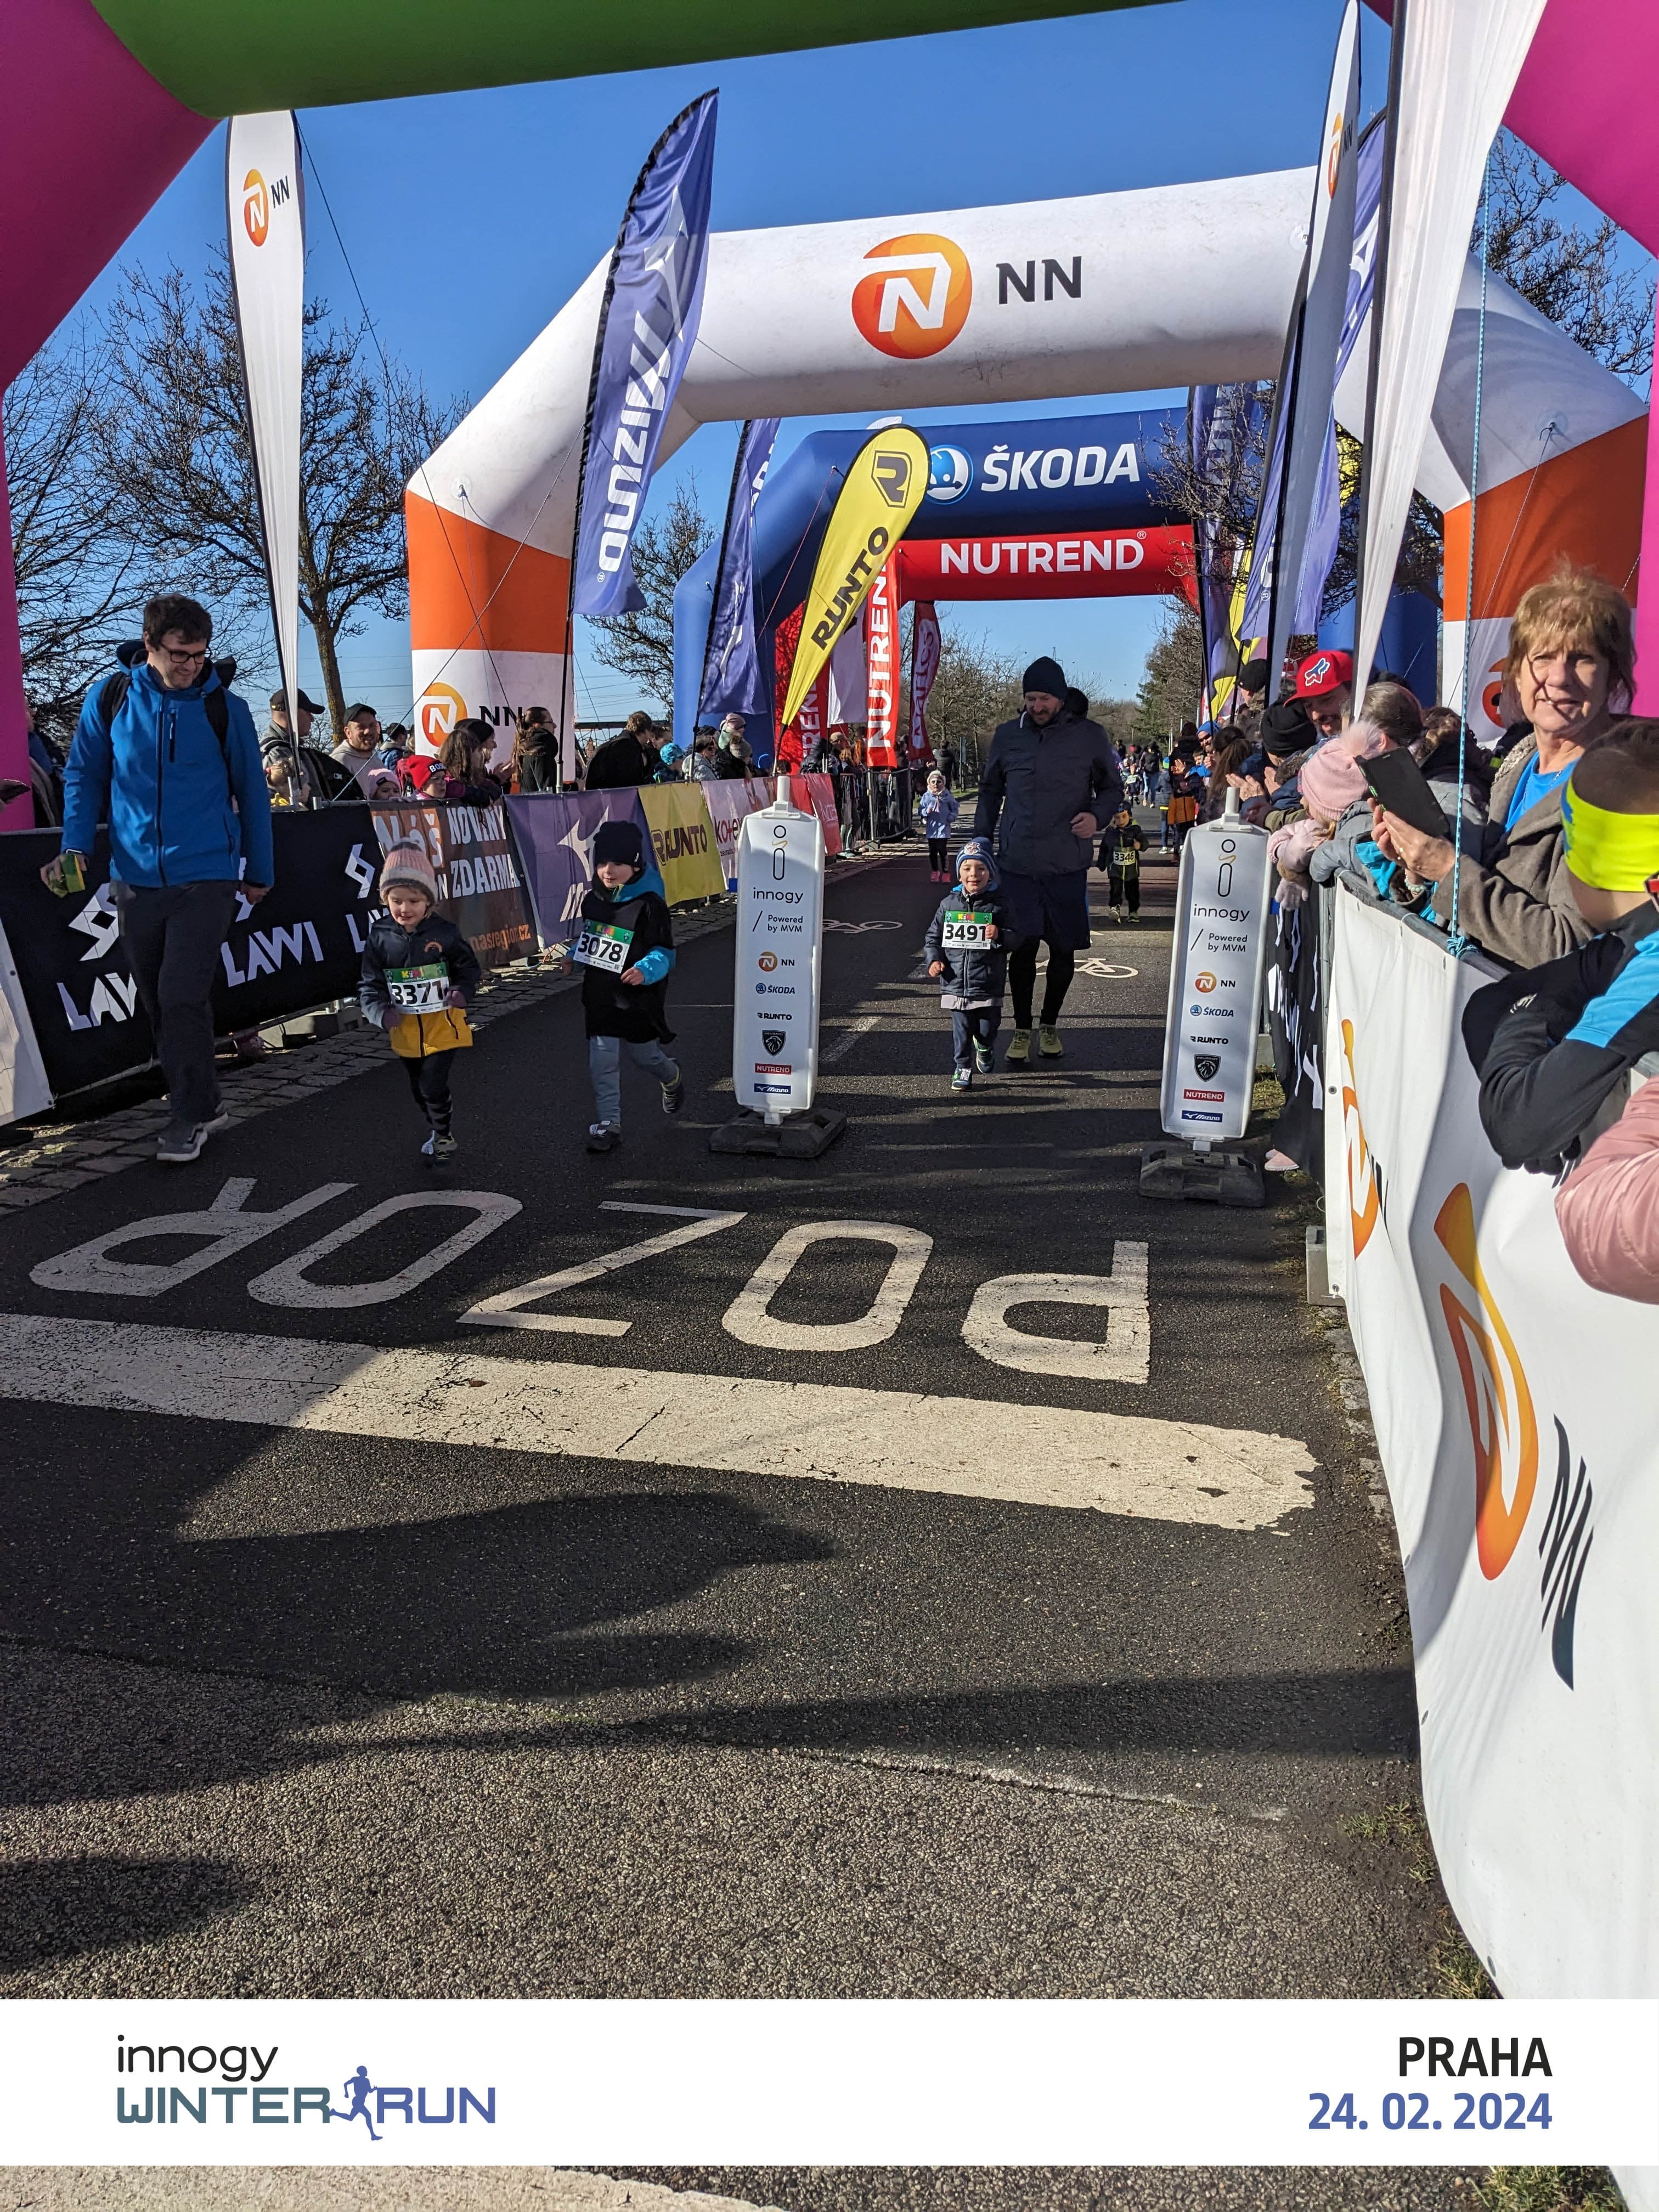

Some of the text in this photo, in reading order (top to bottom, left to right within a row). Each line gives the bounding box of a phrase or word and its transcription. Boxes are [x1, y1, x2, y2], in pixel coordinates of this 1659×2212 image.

[271, 175, 291, 209] NN
[996, 256, 1082, 305] NN
[981, 444, 1141, 492] ŠKODA
[811, 526, 889, 651] RUNTO
[867, 564, 891, 747] NUTREN
[447, 805, 507, 845] NOVINY
[664, 824, 708, 861] RUNTO
[1114, 851, 1135, 861] 3346
[450, 854, 521, 898] ZDARMA
[753, 887, 804, 904] innogy
[768, 914, 803, 923] Powered
[1193, 904, 1250, 922] innogy
[768, 923, 802, 933] by MVM
[945, 923, 986, 941] 3491
[1209, 933, 1248, 943] Powered
[220, 921, 325, 988] LAWI
[578, 934, 623, 963] 3078
[1207, 943, 1246, 952] by MVM
[781, 958, 795, 967] NN
[391, 980, 444, 1005] 3371
[767, 984, 795, 994] ŠKODA
[1220, 980, 1236, 988] NN
[1203, 1006, 1234, 1018] ŠKODA
[1197, 1036, 1229, 1045] RUNTO
[757, 1065, 791, 1073] NUTREND
[1186, 1091, 1223, 1100] NUTREND
[29, 1176, 1150, 1385] POZOR
